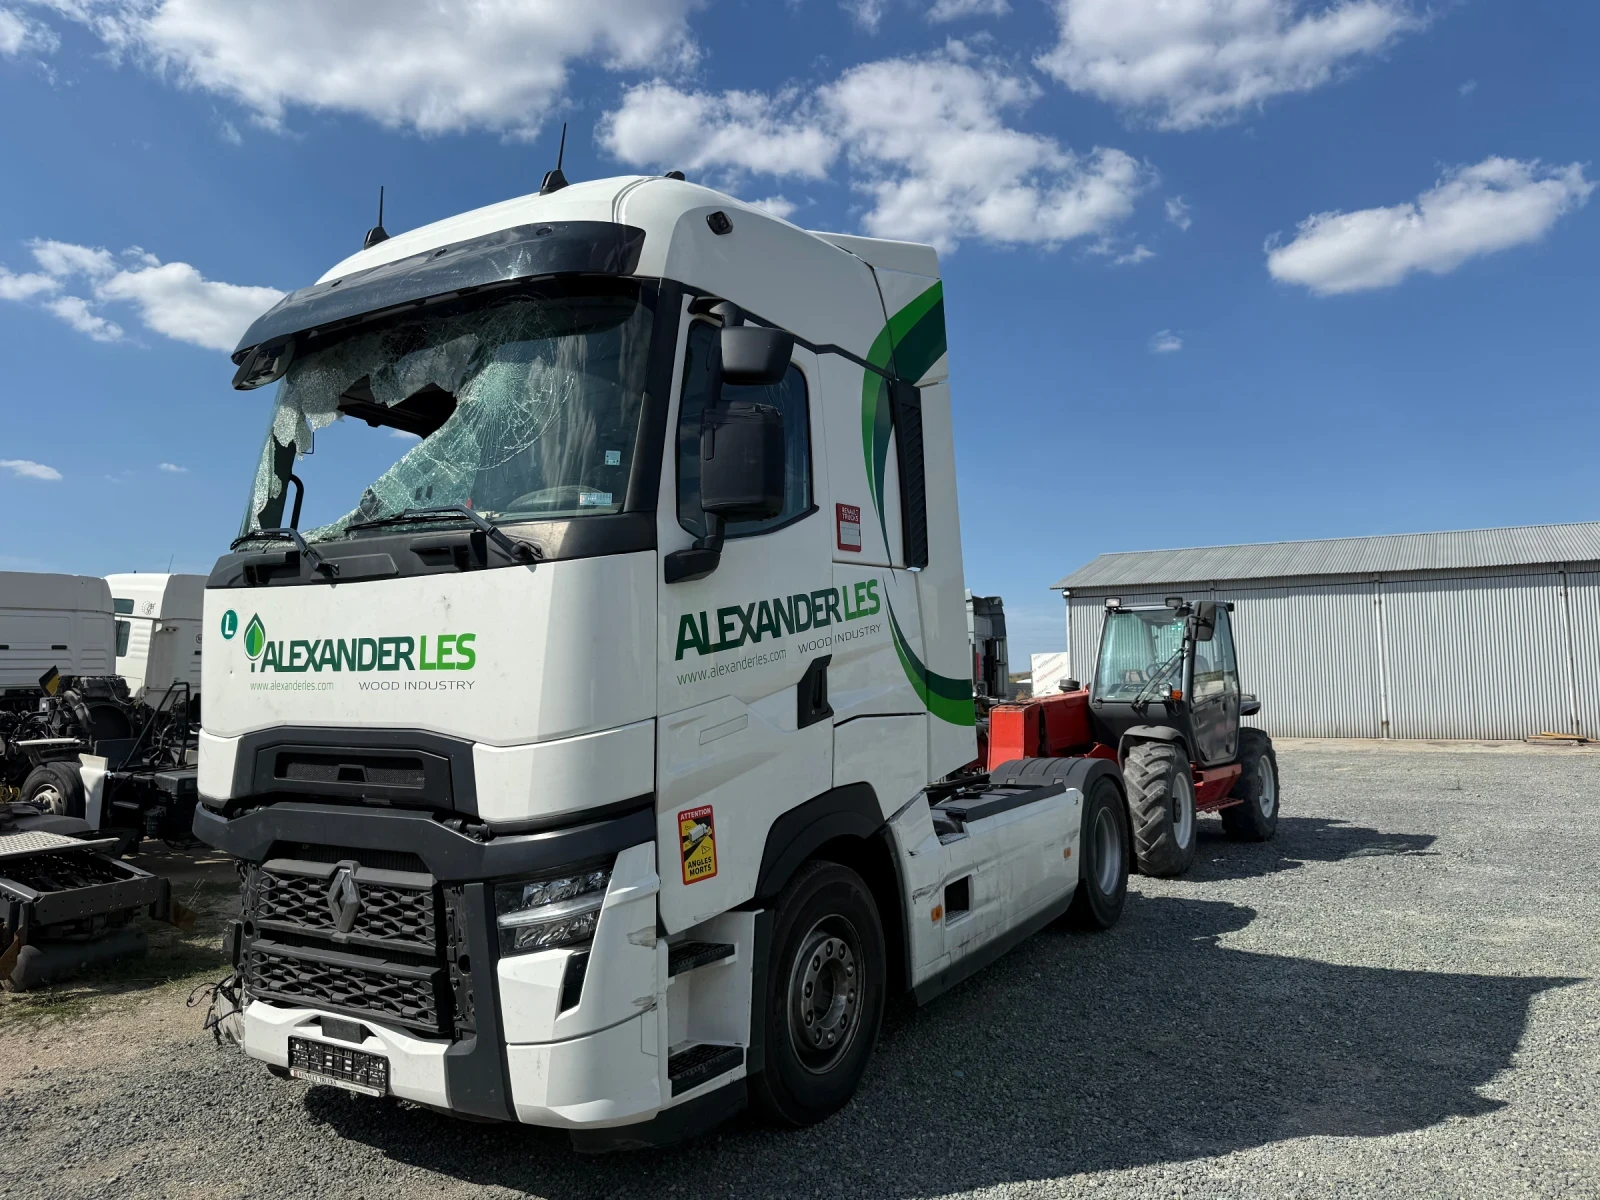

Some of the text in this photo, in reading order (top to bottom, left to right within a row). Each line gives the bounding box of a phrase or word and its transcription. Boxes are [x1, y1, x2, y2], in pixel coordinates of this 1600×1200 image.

[842, 513, 858, 522] TRUCKS
[797, 623, 882, 654] WOOD INDUSTRY
[677, 648, 787, 686] www.alexanderles.com
[250, 680, 334, 691] www.alexanderles.com
[359, 680, 476, 691] WOOD INDUSTRY
[681, 808, 711, 820] ATTENTION
[687, 856, 712, 869] ANGLES
[689, 863, 712, 877] MORTS
